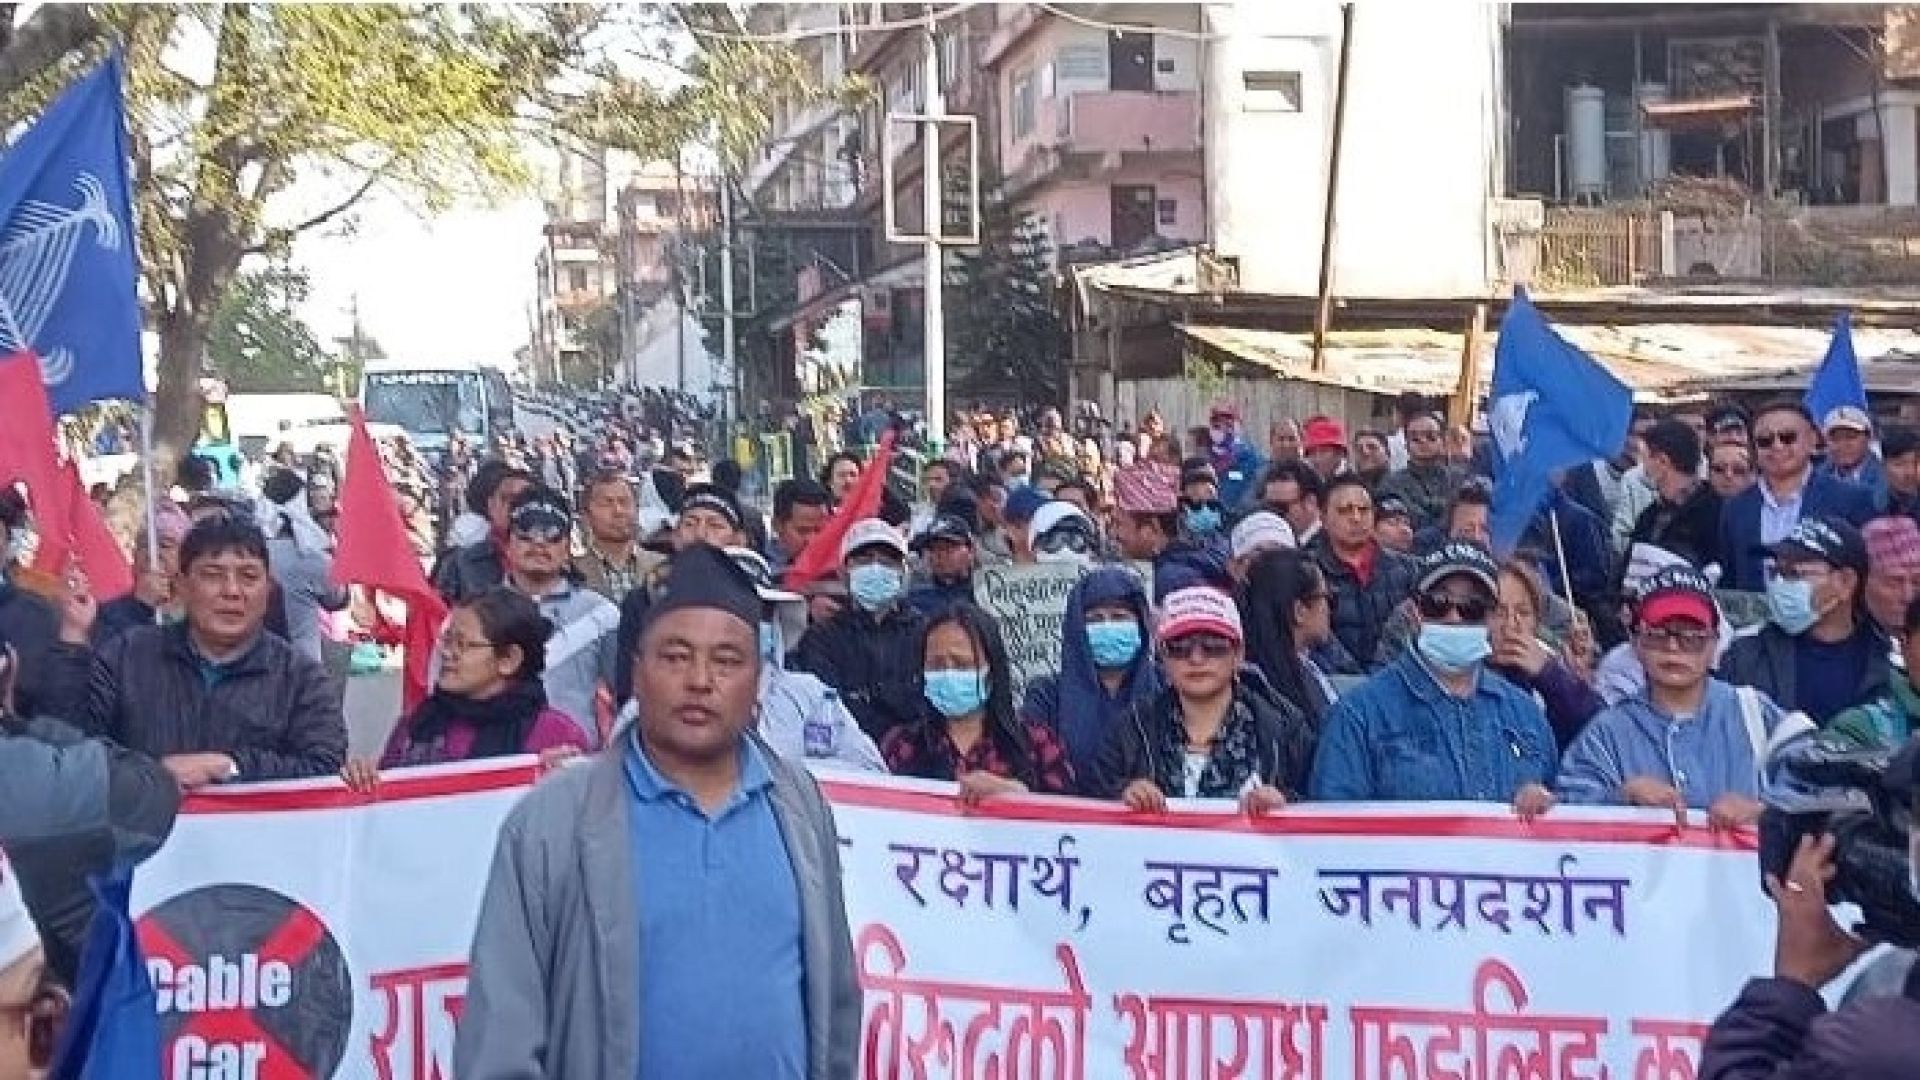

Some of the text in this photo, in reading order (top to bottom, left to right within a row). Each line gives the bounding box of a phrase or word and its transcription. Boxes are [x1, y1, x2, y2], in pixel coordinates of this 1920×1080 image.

[889, 834, 1630, 944] रक्षार्थ, बृहत जनप्रदर्शन
[147, 953, 292, 1014] Cable
[173, 1034, 267, 1080] Car
